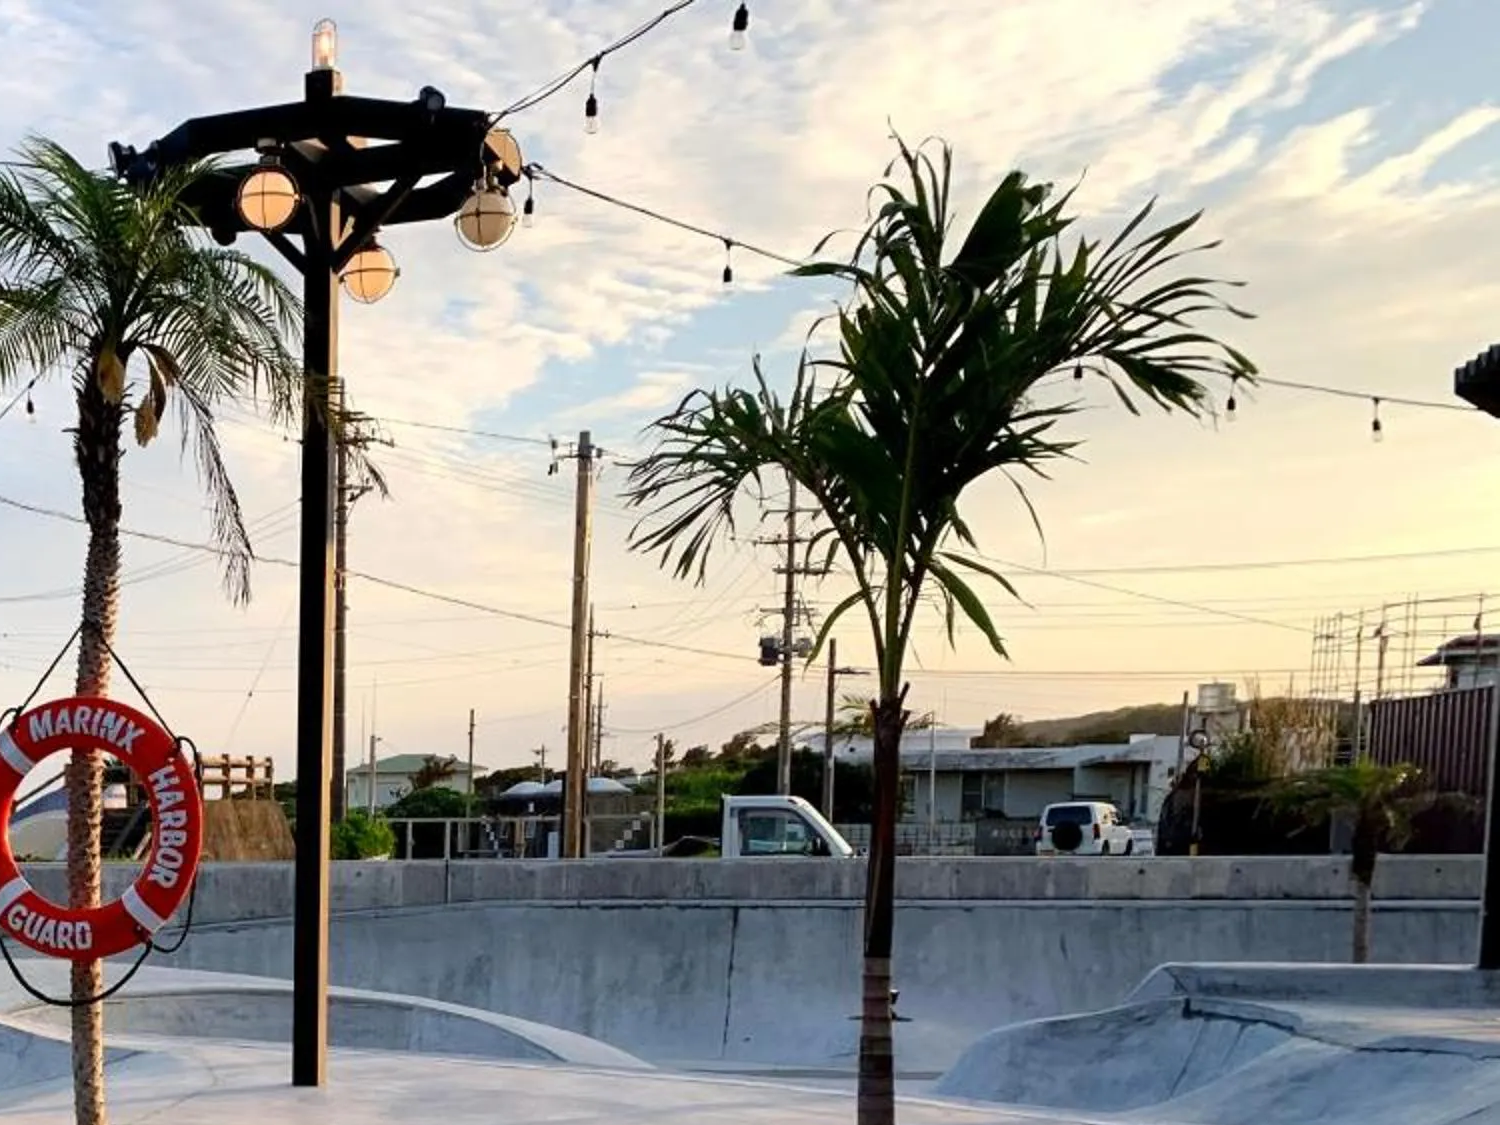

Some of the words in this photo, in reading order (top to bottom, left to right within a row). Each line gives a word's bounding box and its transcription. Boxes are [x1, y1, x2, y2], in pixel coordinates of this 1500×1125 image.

[29, 705, 145, 754] MARINX
[148, 765, 188, 888] HARBOR
[8, 904, 93, 950] GUARD
